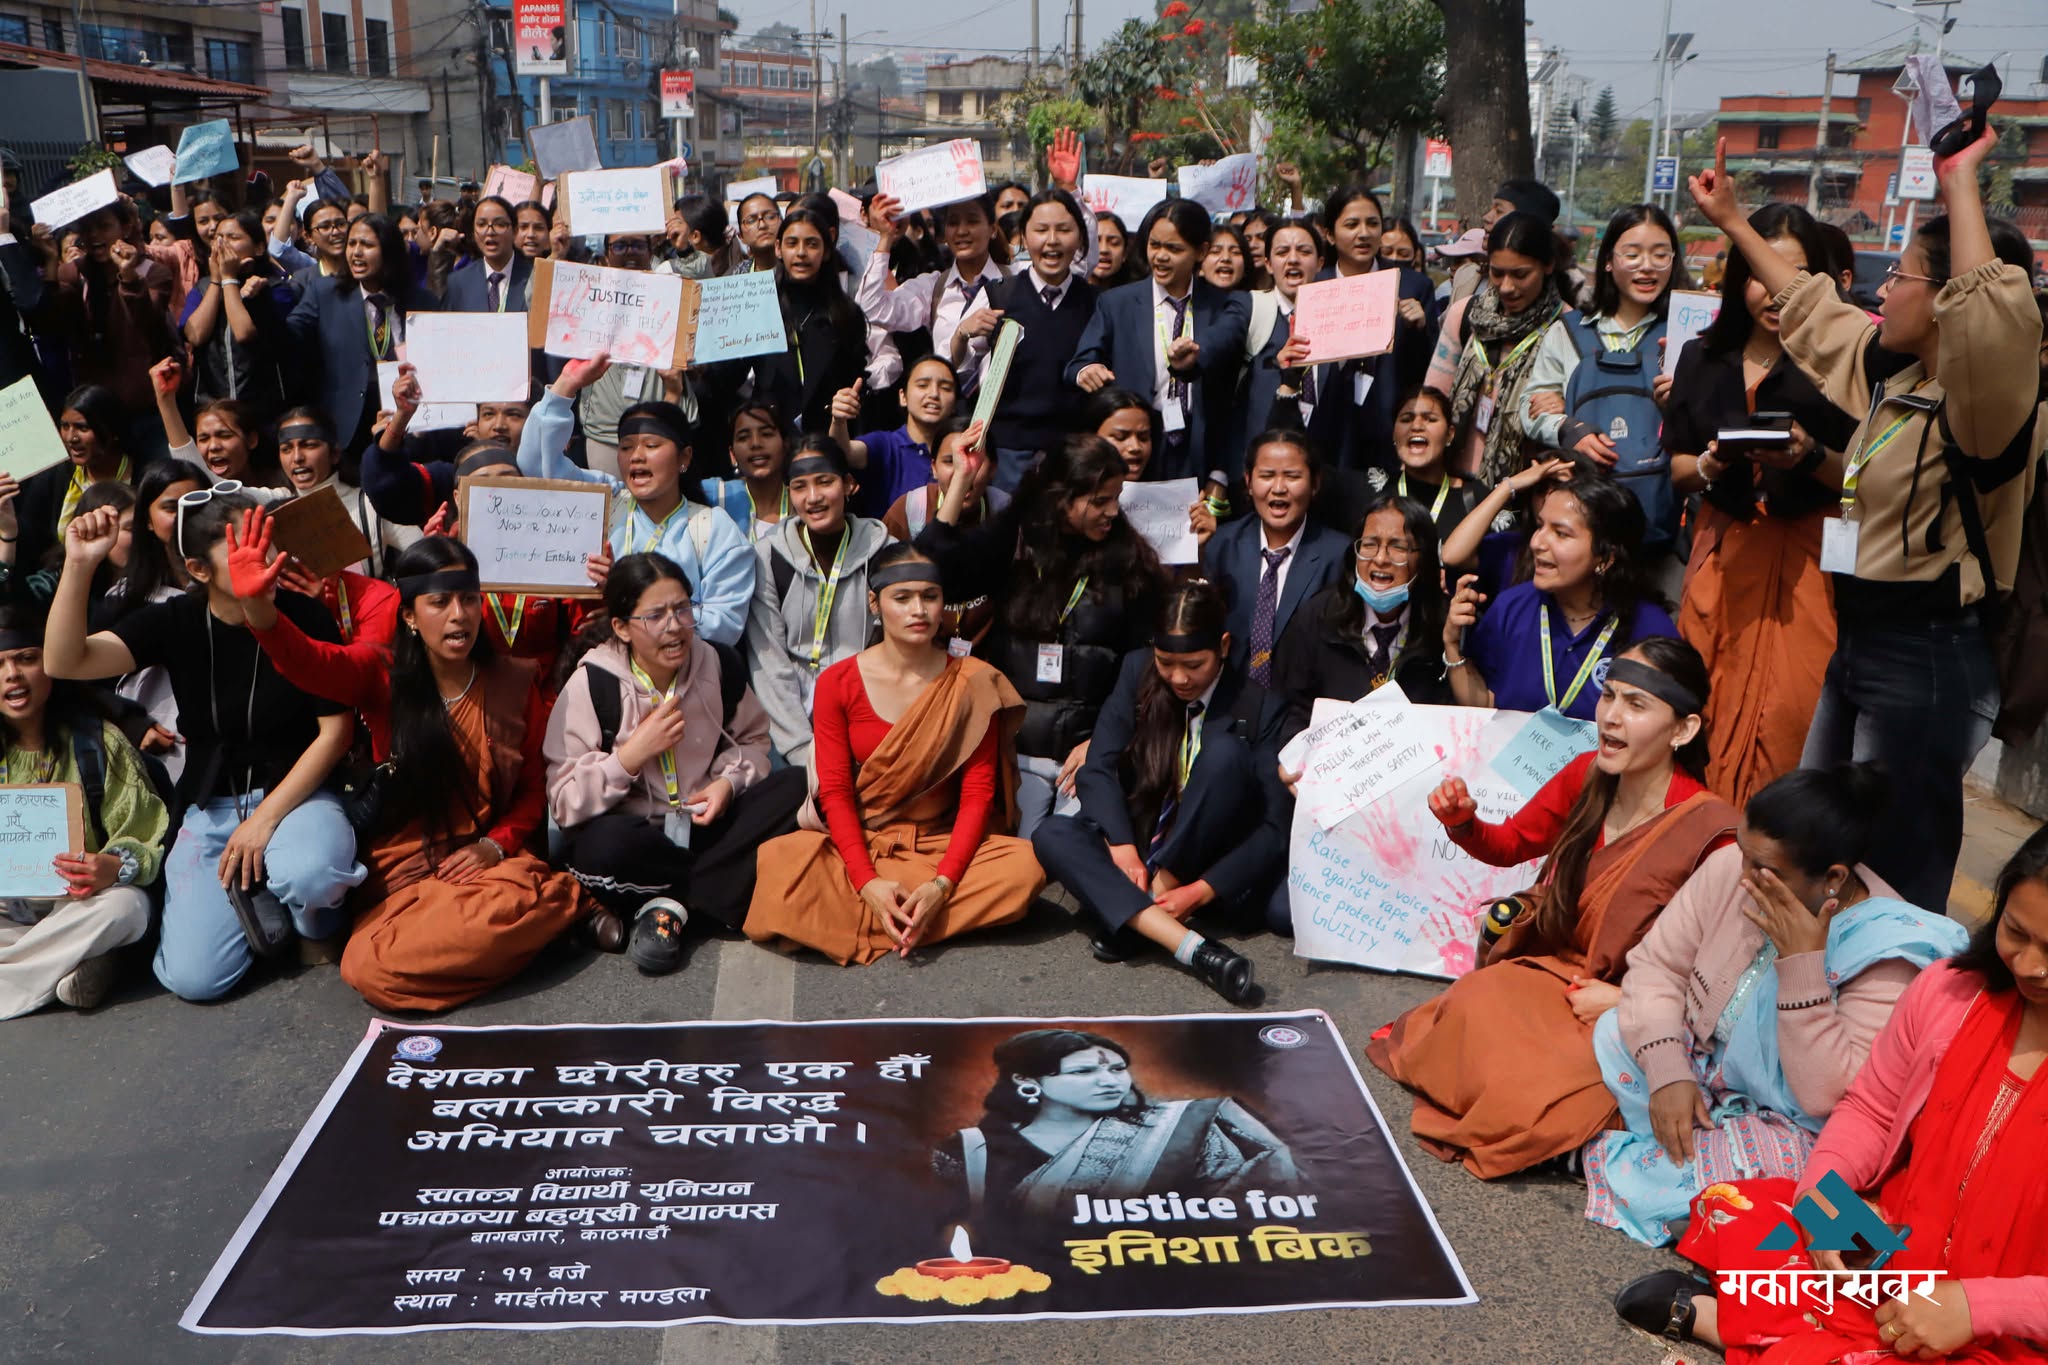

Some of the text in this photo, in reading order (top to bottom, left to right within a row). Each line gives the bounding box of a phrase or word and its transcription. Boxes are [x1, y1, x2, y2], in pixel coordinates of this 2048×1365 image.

[588, 287, 646, 307] JUSTICE
[597, 311, 632, 329] COME
[1301, 709, 1356, 745] PROTECTING
[1529, 729, 1554, 752] HERE
[1313, 744, 1355, 779] FAILURE
[1383, 711, 1406, 730] THAT
[1349, 737, 1395, 772] THREATENS
[1512, 755, 1523, 767] A
[1343, 771, 1384, 803] WOMEN
[1473, 788, 1488, 798] SO
[1481, 805, 1495, 815] the
[1431, 838, 1457, 861] NO
[1307, 831, 1430, 916] Raise your voice
[1290, 866, 1413, 946] Silence protects the
[1321, 866, 1410, 922] against rape
[1312, 905, 1380, 953] GUILTY
[386, 1062, 535, 1089] देशका
[764, 1061, 854, 1085] एक
[432, 1086, 846, 1119] बलात्कारी विरुद्ध
[407, 1122, 623, 1151] अभियान
[416, 1178, 755, 1204] स्वतन्त्र विद्यार्थी युनियन
[525, 1202, 641, 1226] बहुमुखी
[648, 1203, 780, 1222] क्याम्पस
[1073, 1189, 1318, 1224] Justice for
[470, 1229, 566, 1244] बागबजार,
[1064, 1225, 1373, 1274] इनिशा बिक
[405, 1268, 465, 1285] समय
[502, 1267, 533, 1281] ११
[548, 1262, 591, 1280] बजे
[393, 1293, 457, 1312] स्थान
[494, 1287, 608, 1308] माईतीघर
[619, 1287, 711, 1305] मण्डला
